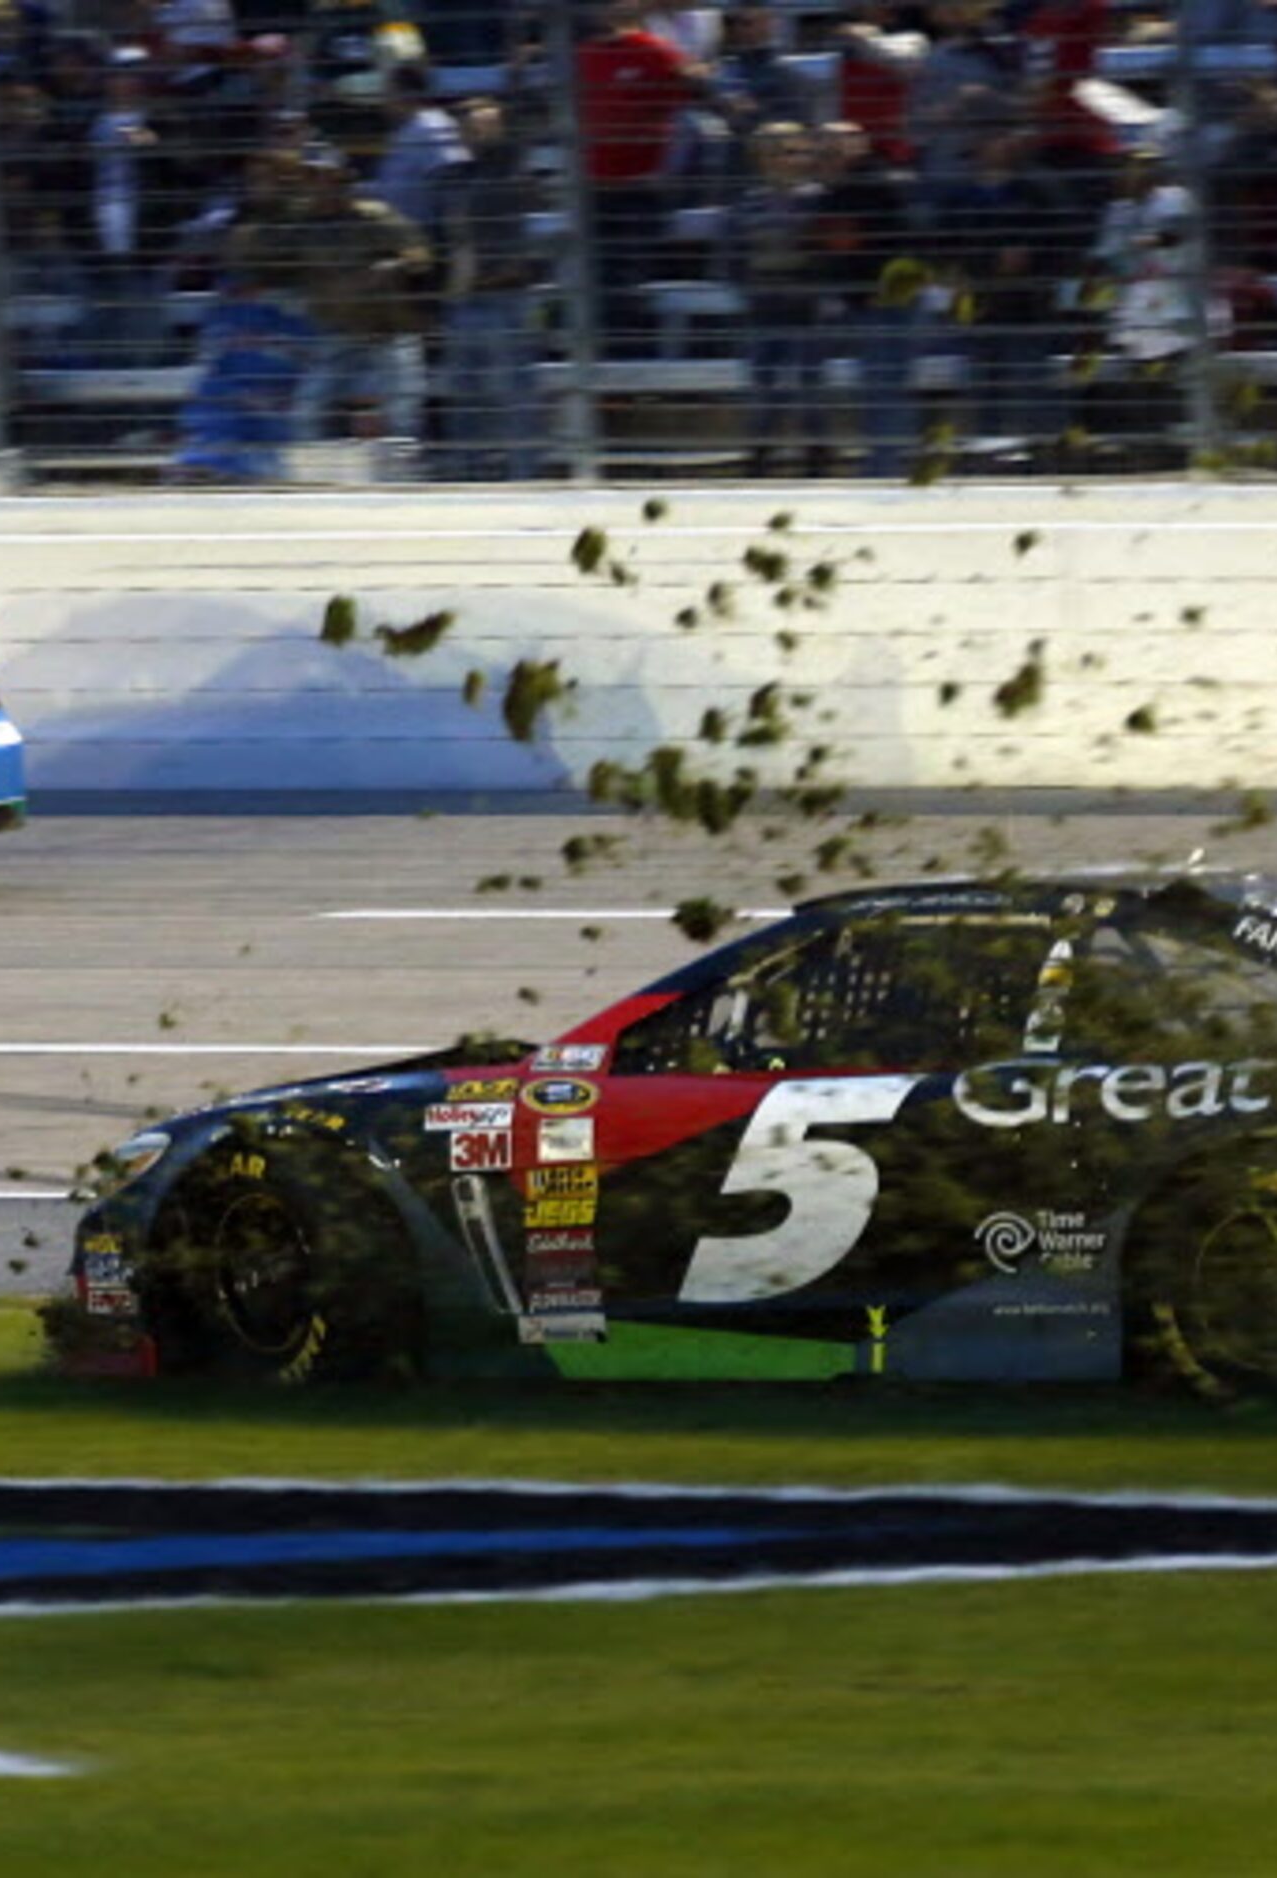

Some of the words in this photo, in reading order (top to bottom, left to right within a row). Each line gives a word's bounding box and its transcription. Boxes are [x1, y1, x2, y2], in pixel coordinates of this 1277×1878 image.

[454, 1132, 508, 1168] 3M
[678, 1073, 930, 1303] 5
[1037, 1210, 1085, 1228] Time
[1038, 1230, 1106, 1250] Warner
